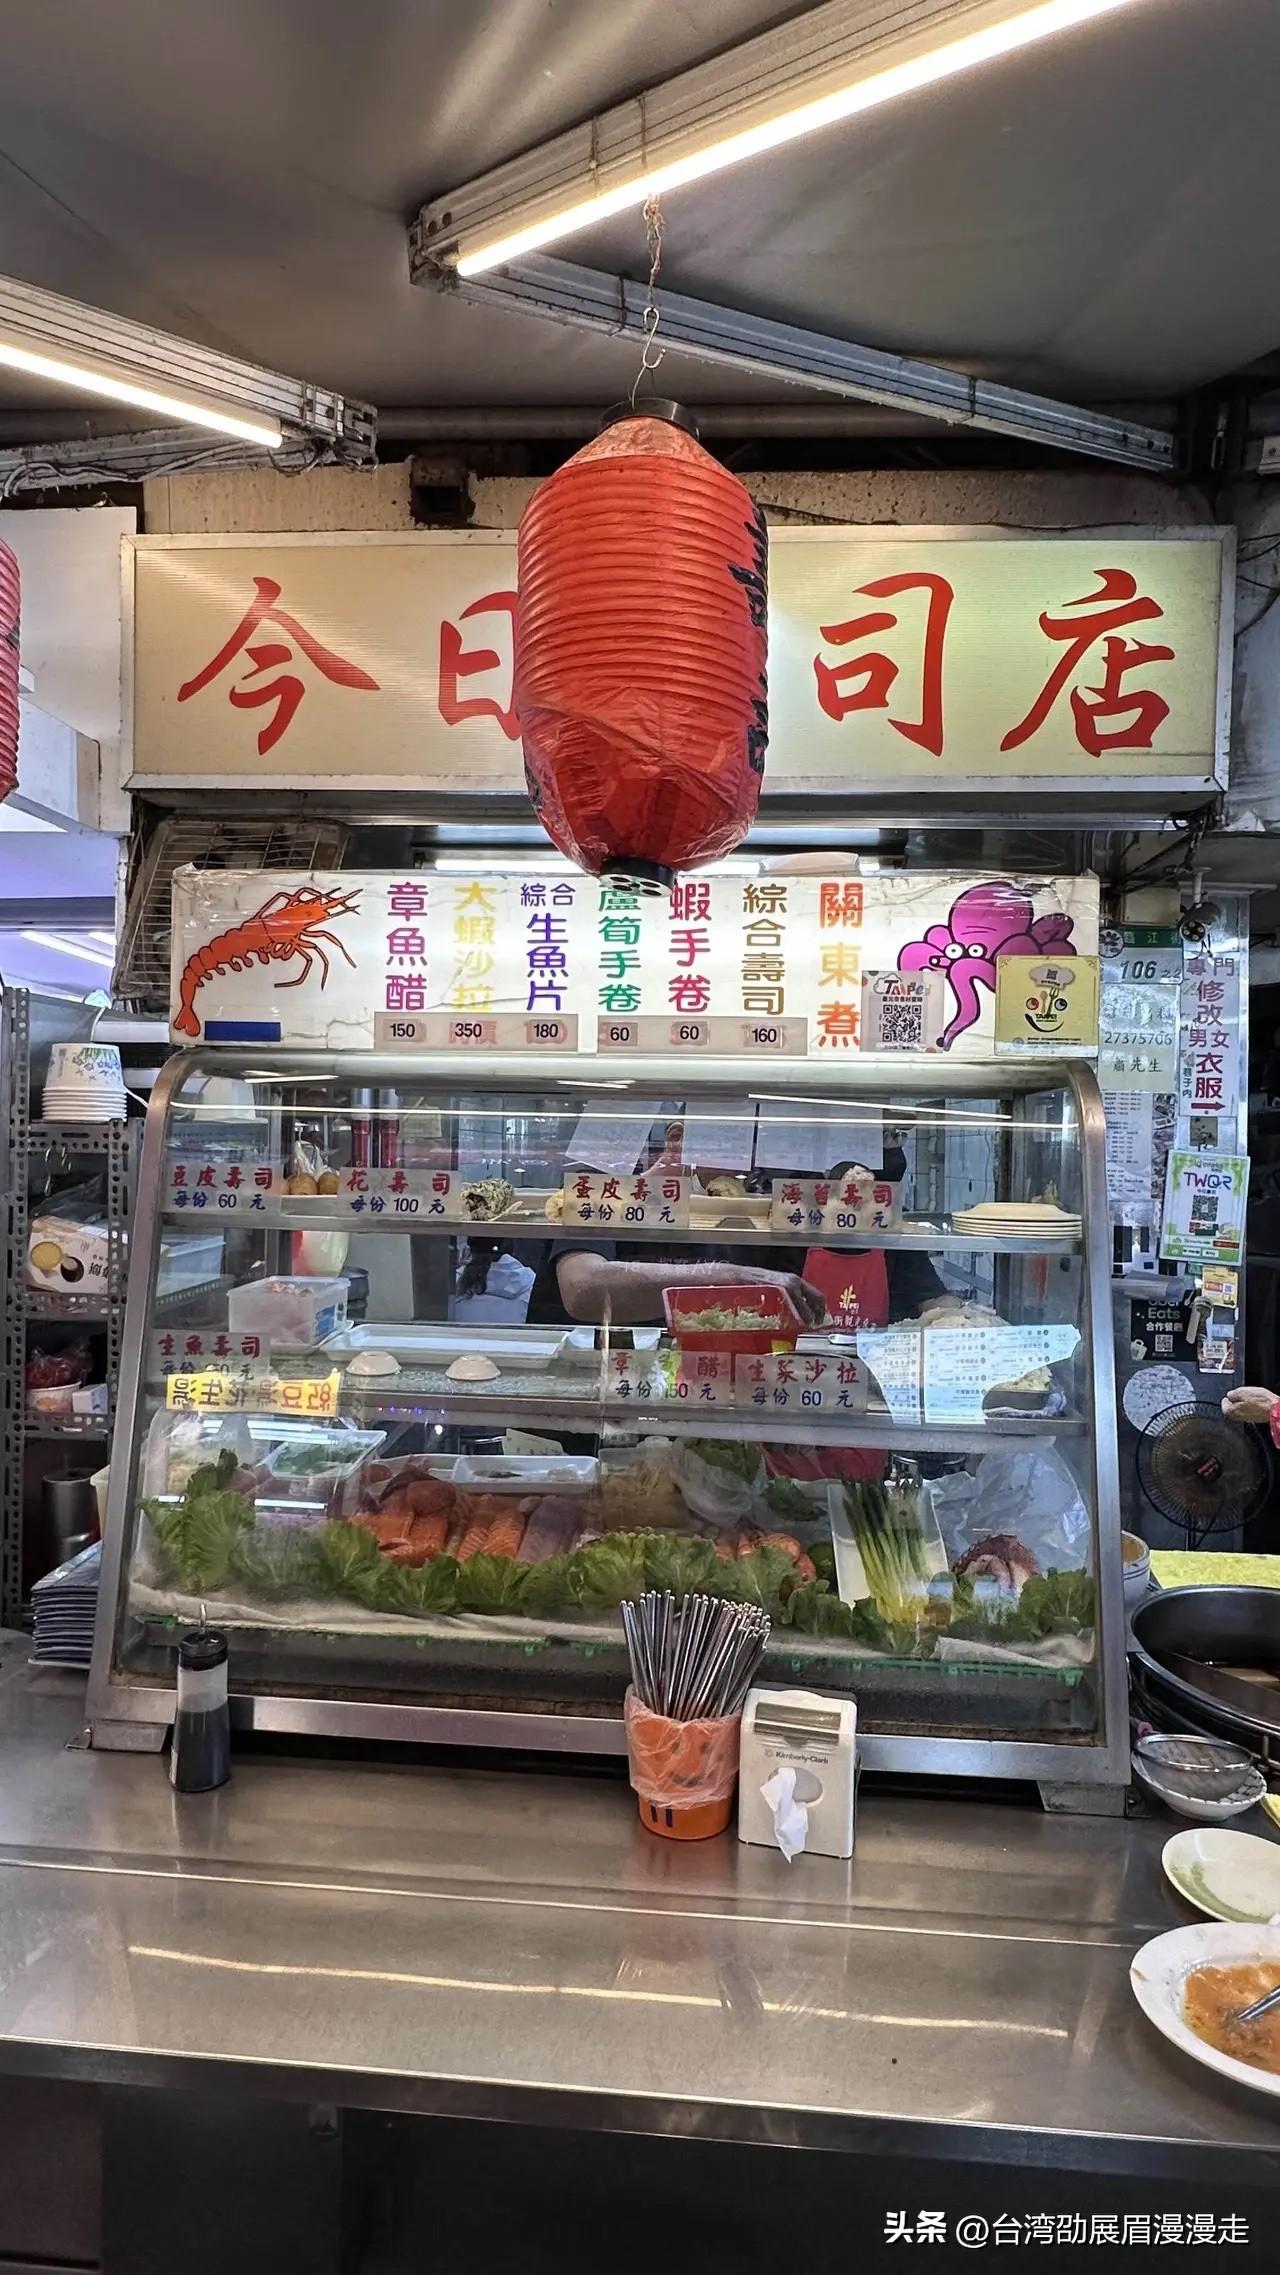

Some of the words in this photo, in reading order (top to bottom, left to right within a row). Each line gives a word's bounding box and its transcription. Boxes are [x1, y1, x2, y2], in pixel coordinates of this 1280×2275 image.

[178, 568, 1175, 757] 今日司店
[520, 883, 576, 907] 綜合
[386, 883, 428, 1010] 章魚醋
[453, 881, 497, 1013] 大蝦沙拉
[668, 881, 712, 1014] 蝦手卷
[741, 882, 788, 1016] 綜合壽司
[526, 913, 570, 1011] 生魚片
[816, 882, 862, 1048] 關東煮
[1120, 960, 1158, 979] 106
[389, 1023, 416, 1038] 150
[454, 1022, 483, 1038] 350
[533, 1023, 559, 1038] 180
[610, 1026, 630, 1041] 60
[679, 1025, 700, 1040] 60
[751, 1027, 777, 1043] 160
[1183, 1171, 1233, 1190] TWQR
[1147, 1307, 1181, 1319] Eats
[775, 1751, 829, 1764] Kimberly-Clark
